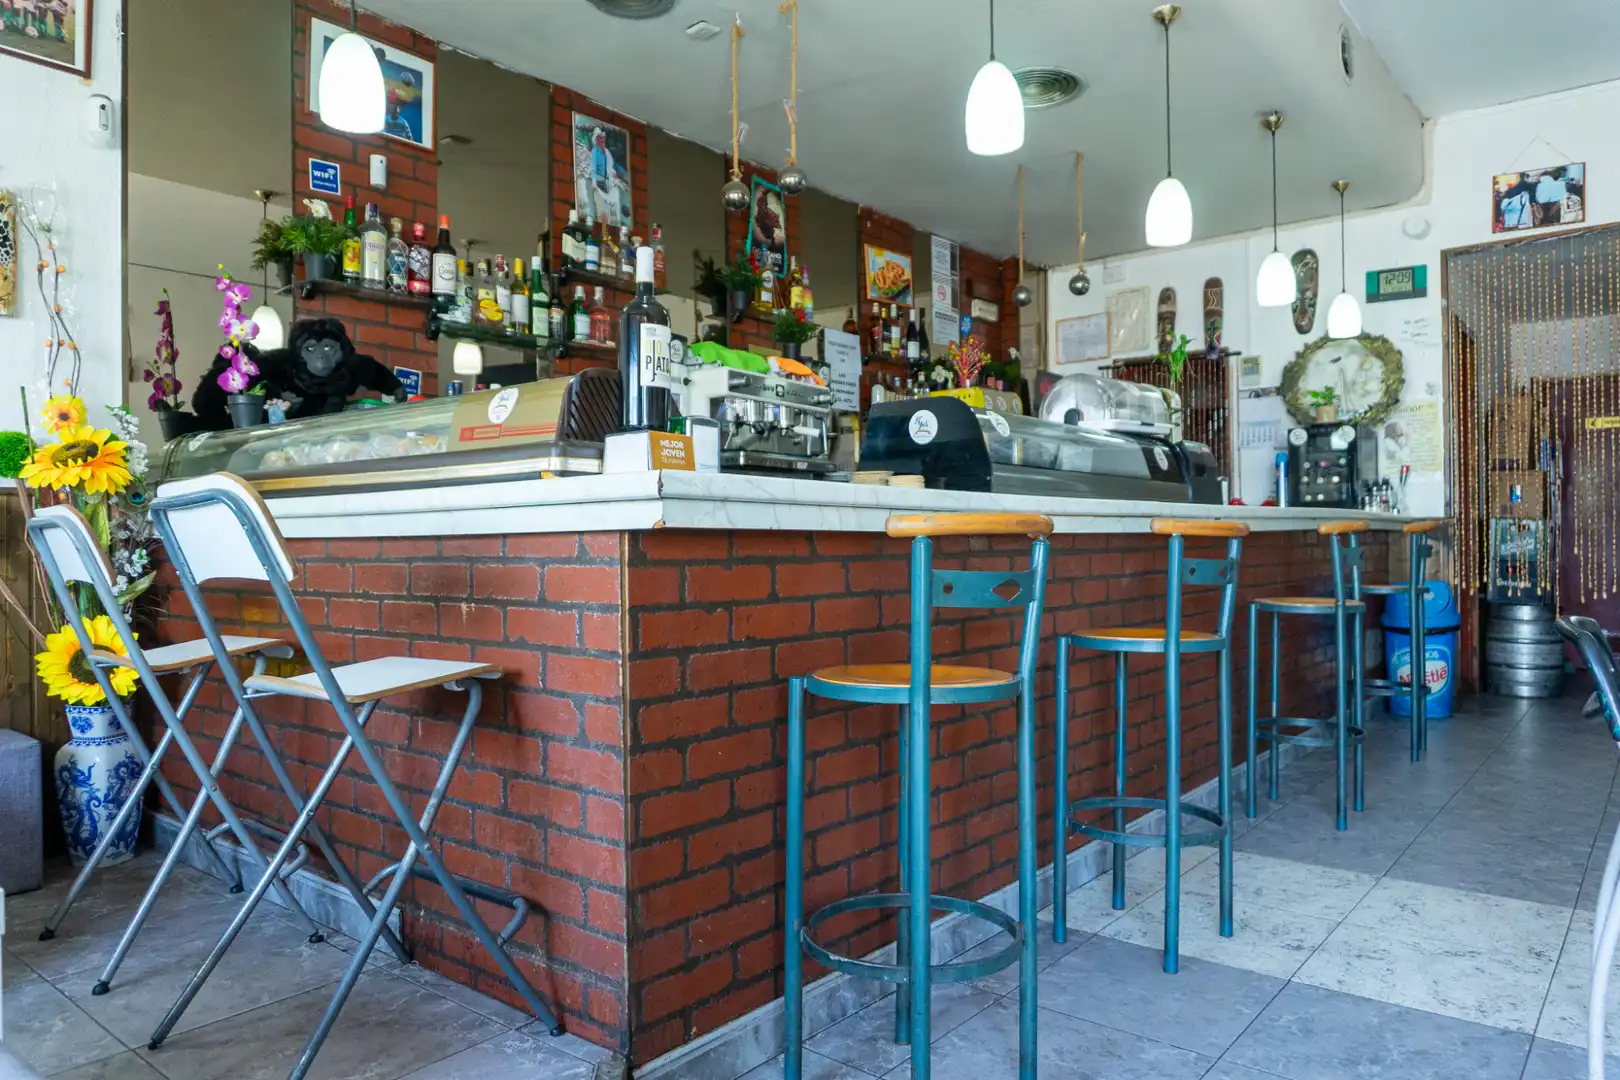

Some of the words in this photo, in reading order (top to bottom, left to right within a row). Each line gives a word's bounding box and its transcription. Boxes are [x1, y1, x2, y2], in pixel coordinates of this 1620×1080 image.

[659, 439, 684, 449] MEJOR
[660, 449, 685, 458] JOVEN
[1399, 665, 1448, 685] Nstlé
